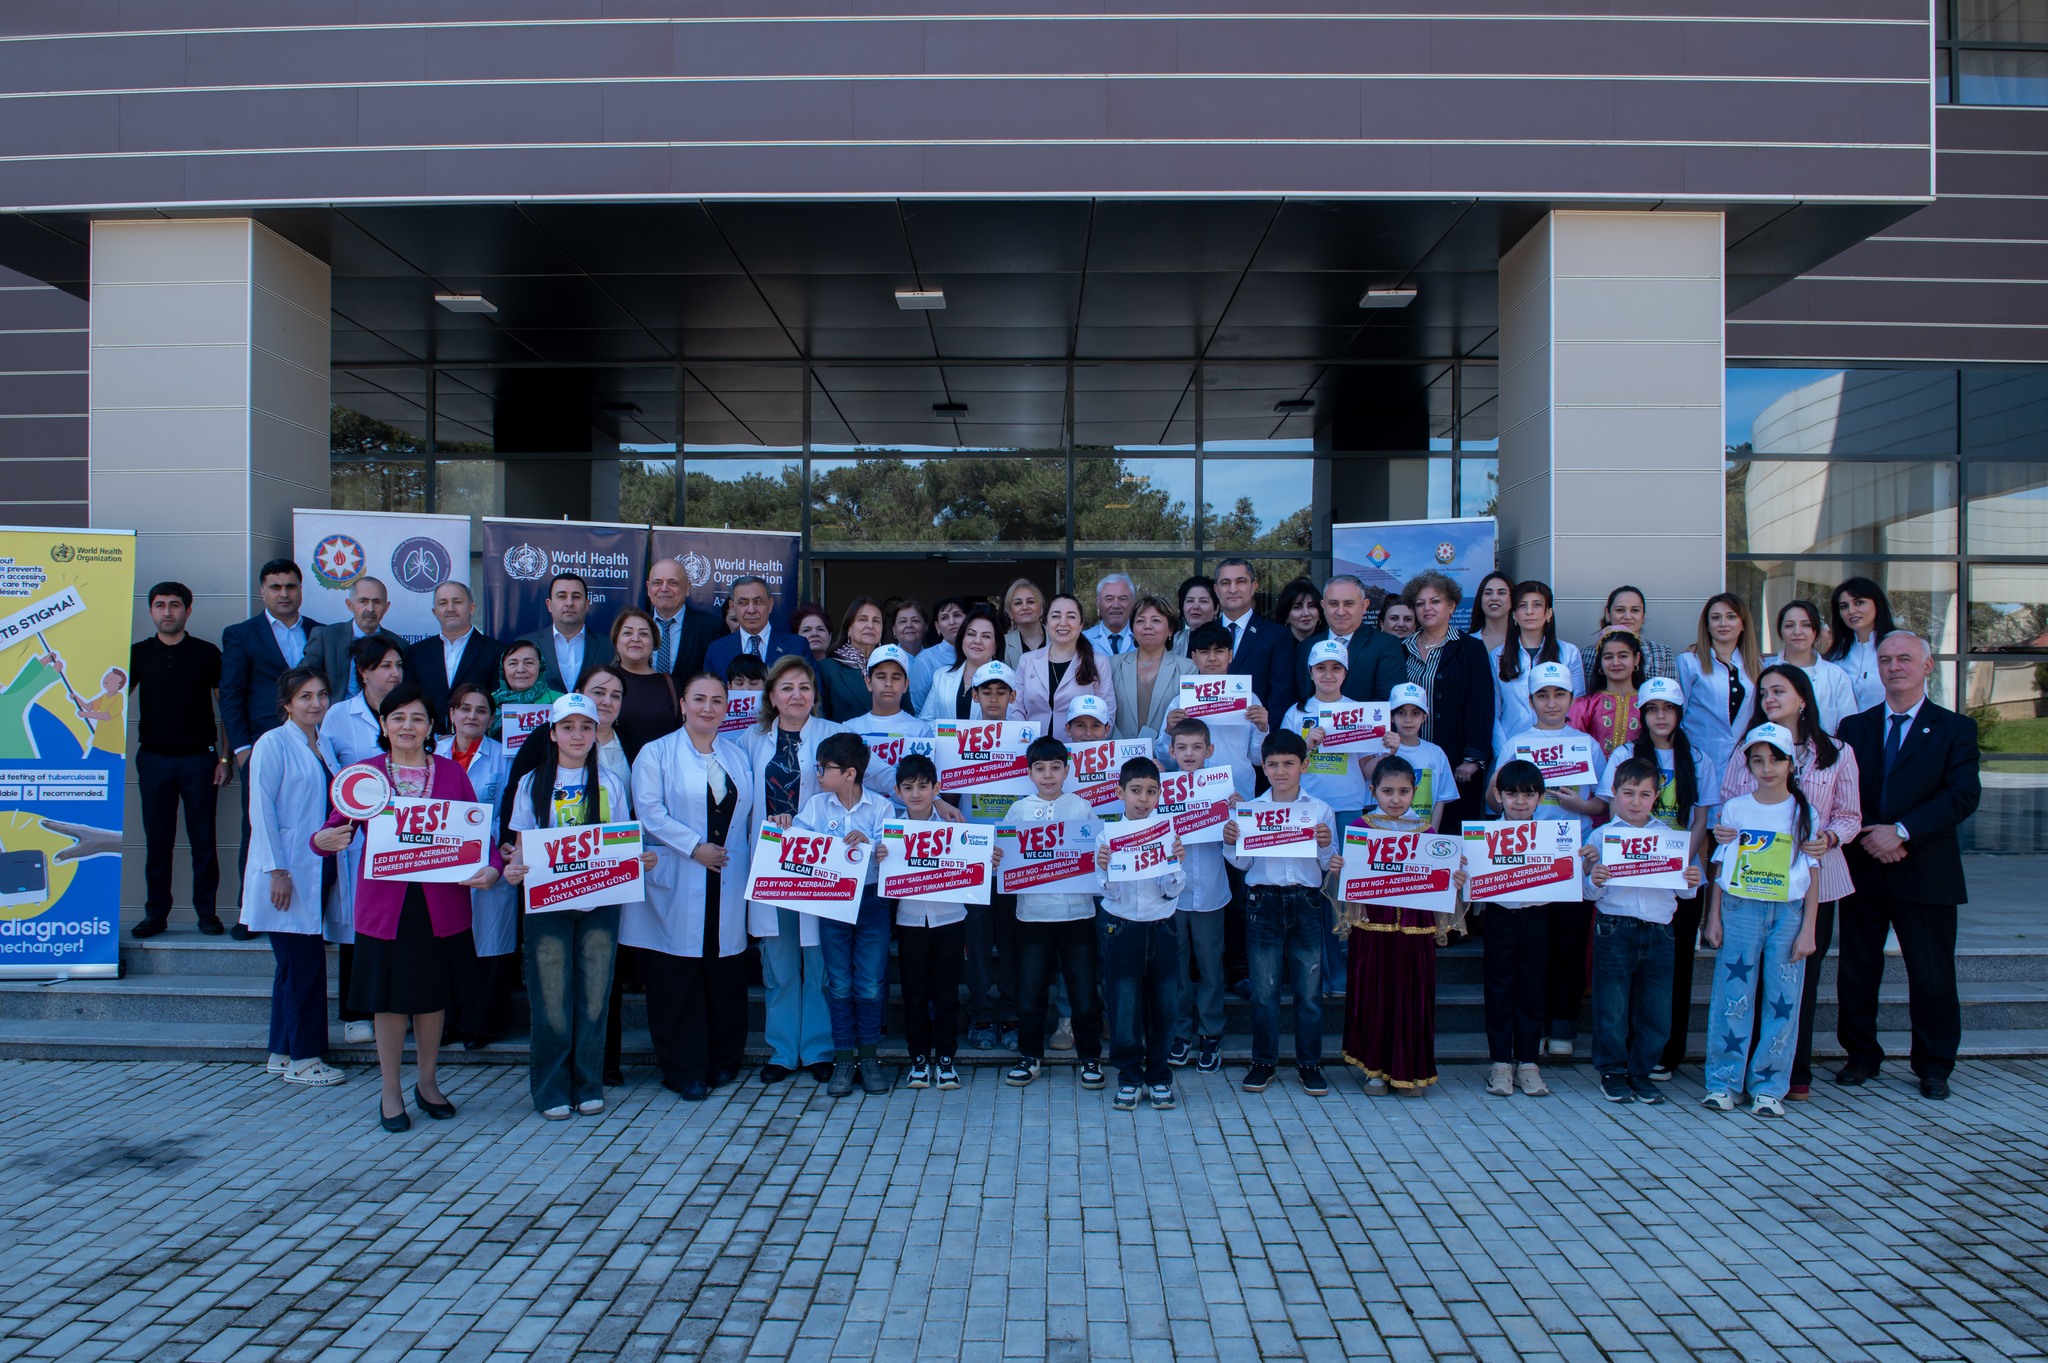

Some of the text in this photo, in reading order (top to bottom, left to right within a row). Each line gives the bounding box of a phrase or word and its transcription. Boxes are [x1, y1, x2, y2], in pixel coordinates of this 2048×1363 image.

[77, 554, 122, 562] Organization
[551, 551, 628, 565] World Health
[714, 559, 782, 571] World Health
[7, 574, 46, 582] accessing
[22, 581, 39, 589] they
[1, 595, 75, 640] TB STIGMA!
[1195, 680, 1226, 699] YES!
[1332, 708, 1364, 727] YES!
[956, 722, 1002, 755] YES!
[1072, 741, 1115, 777] YES!
[1531, 744, 1563, 763] YES!
[7, 774, 35, 782] testing
[48, 773, 96, 781] tuberculosis
[942, 771, 952, 779] LED
[963, 768, 975, 776] NGO
[1207, 772, 1228, 781] HHPA
[943, 778, 967, 788] POWERED
[1081, 790, 1092, 798] NGO
[1098, 794, 1110, 803] ZIBA
[1159, 805, 1170, 813] WE
[1172, 804, 1184, 812] CAN
[395, 801, 450, 836] YES!
[1178, 824, 1191, 834] AYAZ
[1192, 814, 1221, 830] HUSEYNOV
[1255, 808, 1291, 828] YES!
[402, 834, 414, 842] WE
[415, 835, 431, 843] CAN
[435, 836, 450, 844] END
[903, 827, 953, 860] YES!
[1016, 822, 1064, 854] YES!
[1485, 821, 1537, 859] YES!
[1620, 835, 1659, 855] YES!
[544, 828, 601, 868] YES!
[779, 837, 833, 864] YES!
[1367, 834, 1420, 864] YES!
[374, 853, 414, 865] LED BY NGO
[374, 862, 403, 873] POWERED
[414, 859, 430, 867] SONA
[556, 859, 616, 872] WE CAN END TB
[1135, 845, 1166, 872] YES!
[784, 862, 838, 880] WE CAN END TB
[1005, 866, 1038, 880] LED BY NGO
[549, 869, 610, 894] 24 MART 2026
[1005, 876, 1028, 887] POWERED
[1029, 874, 1036, 882] BY
[1472, 879, 1483, 887] LED
[1494, 873, 1508, 882] NGO
[1472, 885, 1497, 895] POWERED
[1506, 879, 1526, 888] SAADAT
[1527, 872, 1558, 884] BAYRAMOVA
[1745, 876, 1784, 886] curable.
[543, 872, 631, 906] DÜNYA VƏRƏM GÜNÜ
[887, 886, 913, 896] POWERED
[923, 882, 944, 891] TURKAN
[1347, 890, 1374, 898] POWERED
[1384, 886, 1404, 894] SABINA
[1405, 883, 1434, 892] KARIMOVA
[0, 917, 110, 942] diagnosis
